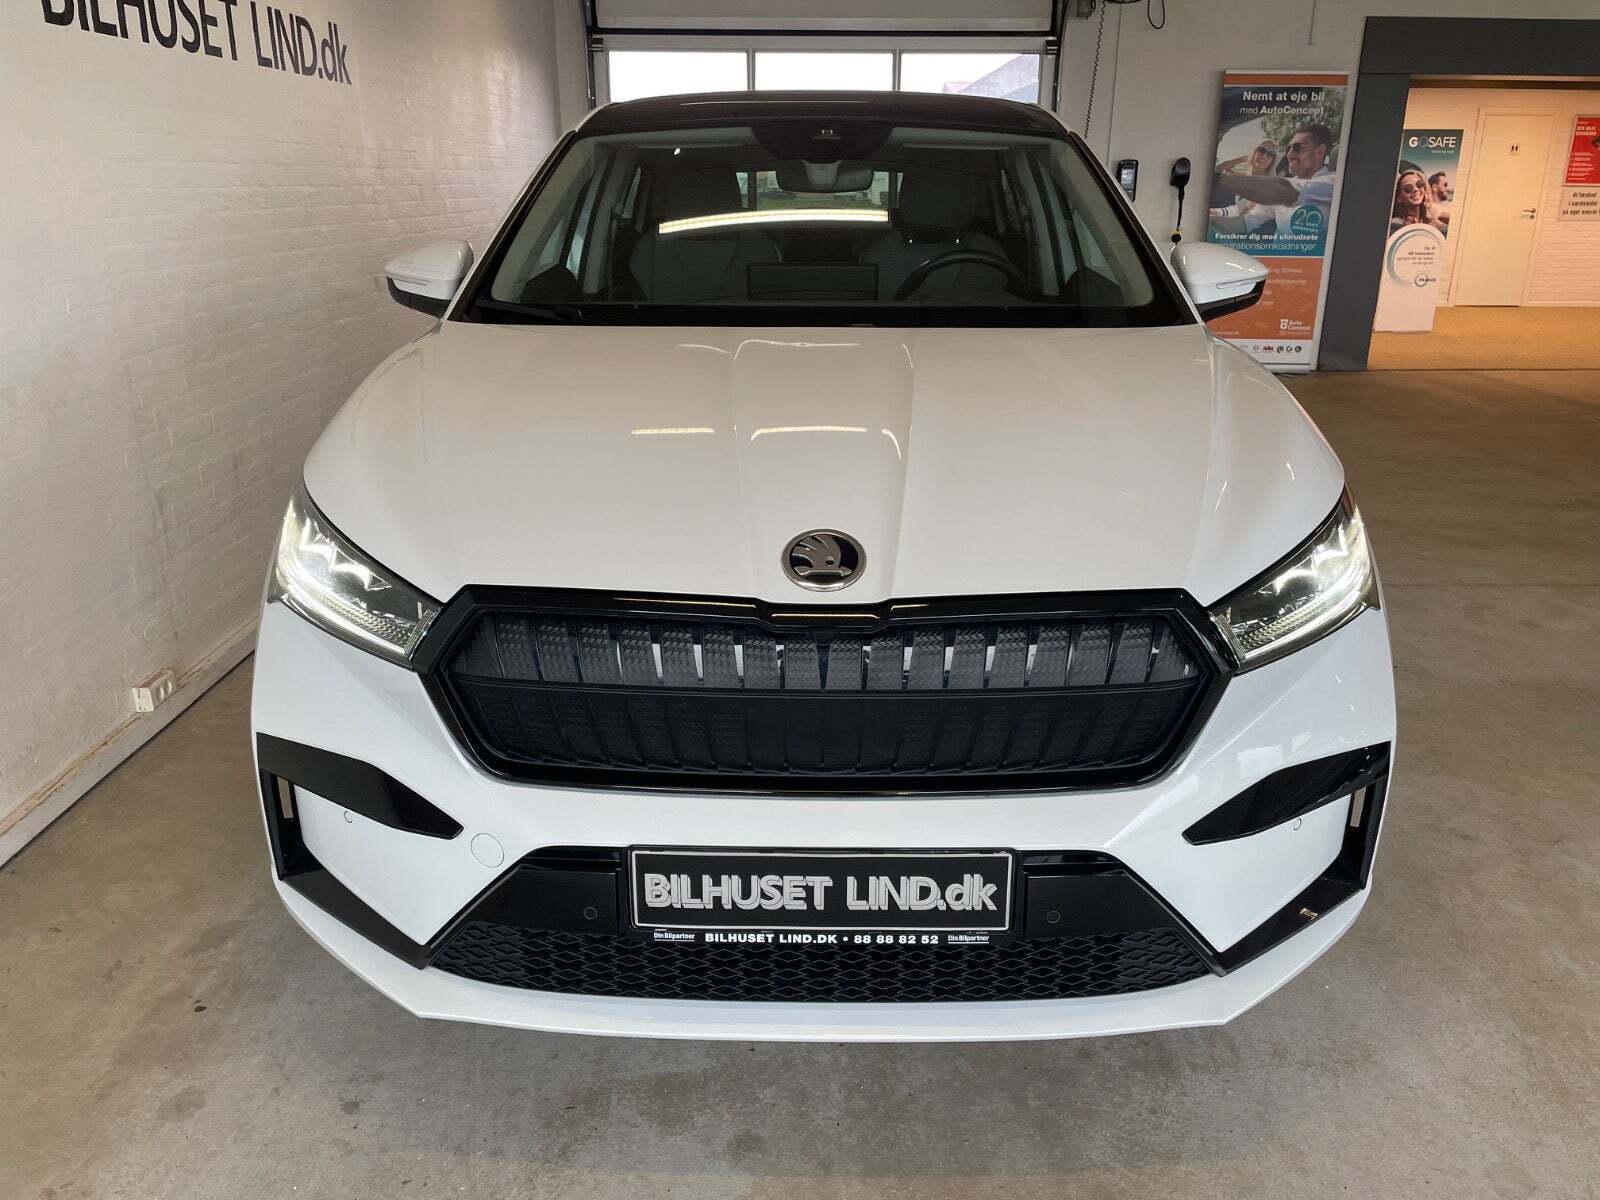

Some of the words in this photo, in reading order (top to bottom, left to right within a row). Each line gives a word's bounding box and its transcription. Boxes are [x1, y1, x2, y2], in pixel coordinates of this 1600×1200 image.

[251, 1, 352, 85] LIND.dk
[1243, 91, 1273, 101] Nemt
[1276, 91, 1287, 101] at
[1290, 91, 1308, 102] eje
[1311, 91, 1325, 101] bil
[1240, 106, 1259, 114] med
[1260, 105, 1324, 116] AutoConcept
[1215, 232, 1248, 240] Forsikrer
[1248, 233, 1261, 241] dig
[644, 873, 833, 911] BILHUSET
[846, 873, 998, 911] LIND.dk
[705, 933, 774, 943] BILHUSET
[779, 934, 837, 943] LIND.DK
[854, 935, 871, 944] 88
[876, 935, 893, 944] 88
[898, 935, 916, 944] 82
[921, 935, 938, 944] 52
